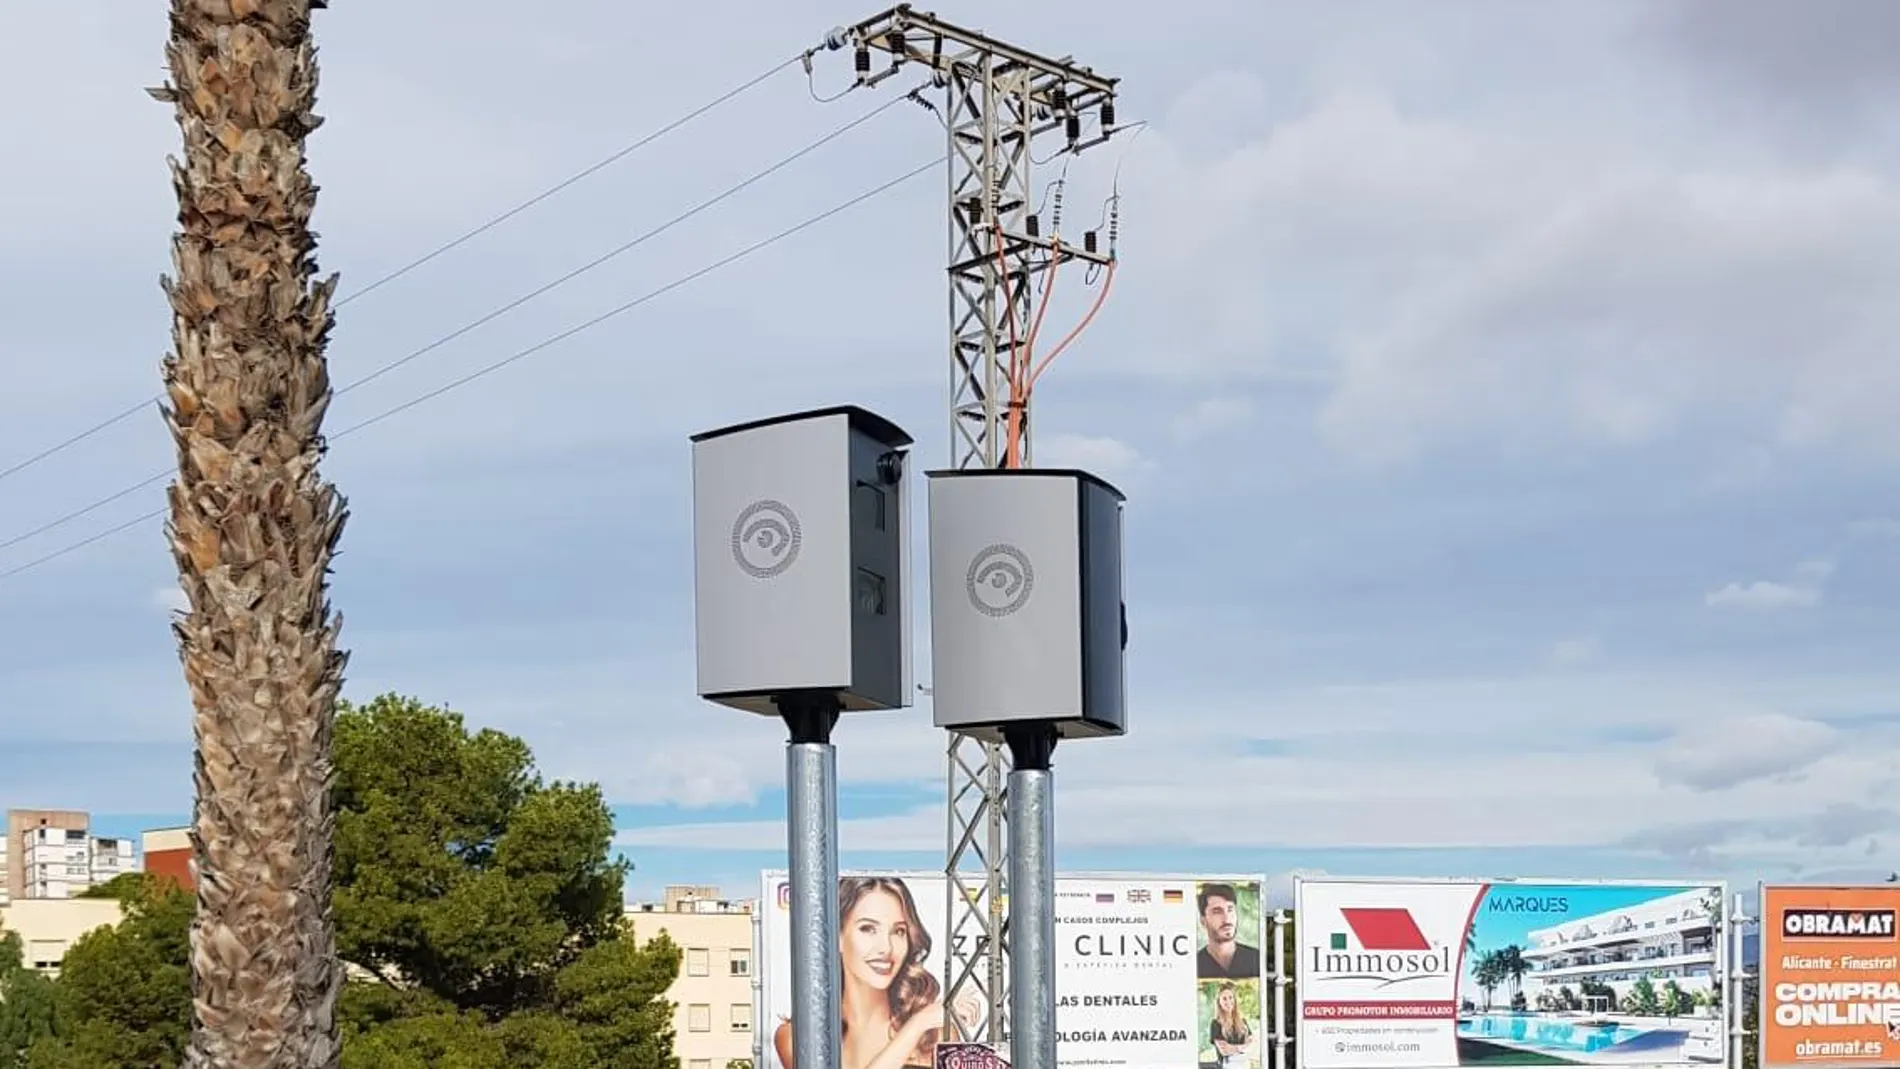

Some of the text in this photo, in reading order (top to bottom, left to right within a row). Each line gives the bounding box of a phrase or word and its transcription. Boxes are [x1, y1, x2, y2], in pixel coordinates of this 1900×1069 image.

[1489, 897, 1568, 912] MARQUES
[1063, 916, 1093, 924] CASOS
[1785, 914, 1893, 934] OBRAMAT
[1075, 934, 1189, 956] CLINIC
[1309, 946, 1449, 973] Immosol
[1782, 956, 1832, 970] Alicante
[1775, 983, 1900, 1001] COMPRA
[1083, 995, 1158, 1006] DENTALES
[1304, 1006, 1453, 1016] GRUPO PROMOTOR INMOBILIARIO
[1775, 1003, 1900, 1026] ONLINE
[1055, 1029, 1187, 1042] OLOGÍA AVANZADA
[1346, 1041, 1420, 1052] immosol.com
[1796, 1039, 1882, 1055] obramat.es
